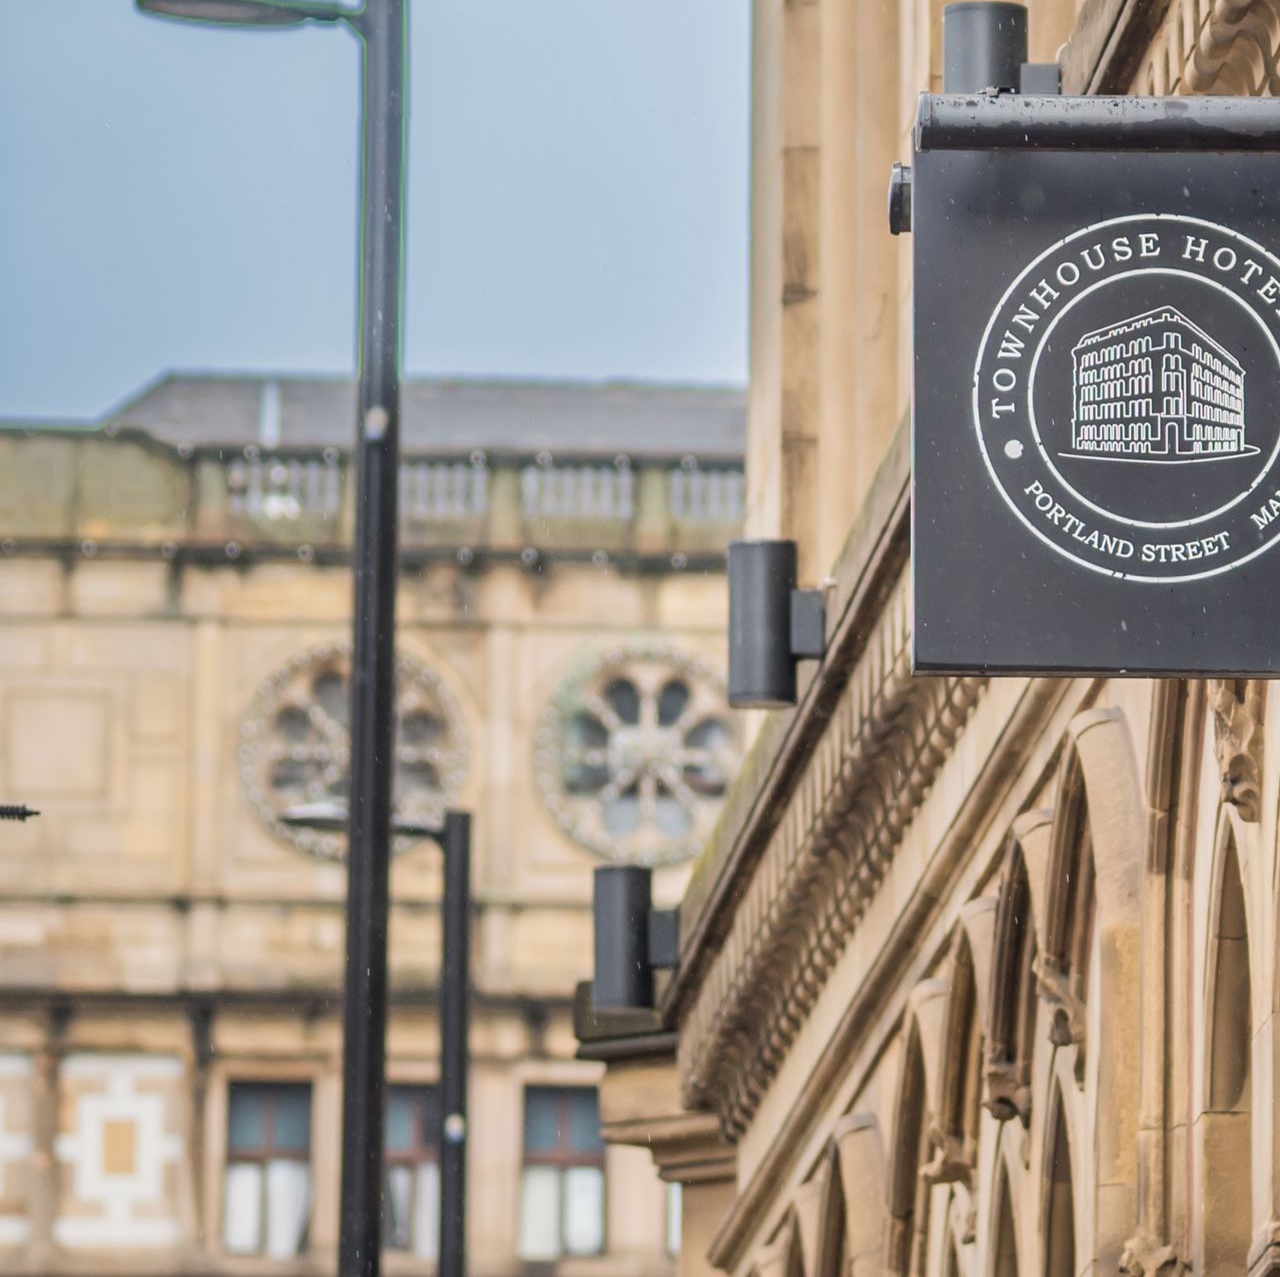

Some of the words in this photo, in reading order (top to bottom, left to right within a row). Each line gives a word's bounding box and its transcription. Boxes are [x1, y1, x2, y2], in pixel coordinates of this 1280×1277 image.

[991, 233, 1161, 418] TOWNHOUSE
[1023, 479, 1135, 560] PORTLAND
[1140, 530, 1231, 563] STREET
